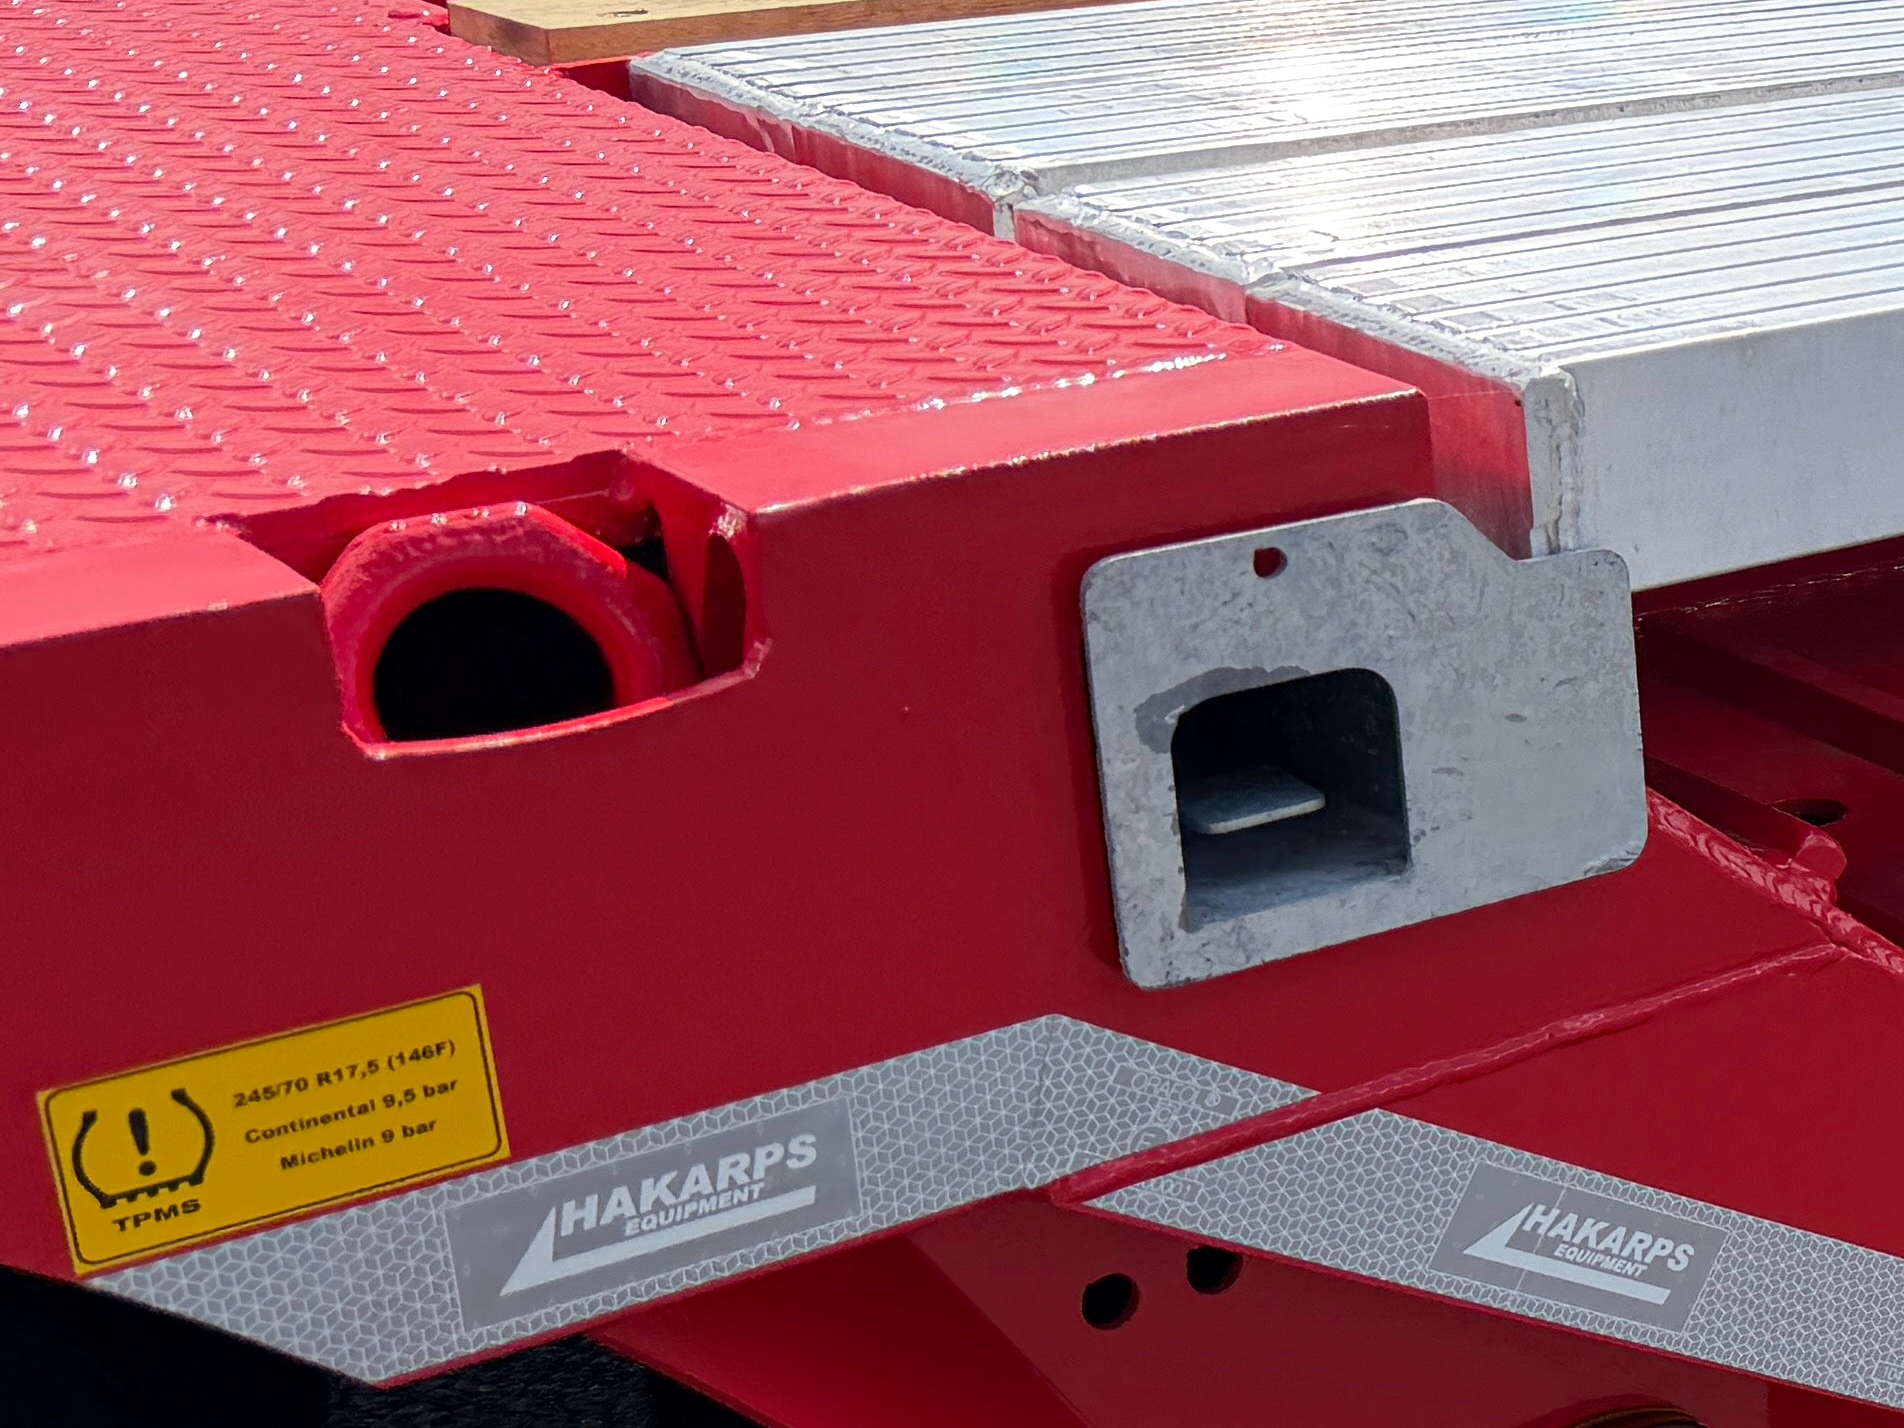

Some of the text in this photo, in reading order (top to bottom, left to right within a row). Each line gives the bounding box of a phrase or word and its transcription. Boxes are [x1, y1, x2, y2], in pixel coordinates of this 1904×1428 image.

[233, 1039, 456, 1109] 245/70 R17,5 (146F)
[245, 1077, 458, 1145] Continental 9,5 bar
[280, 1118, 437, 1170] Michelin 9 bar
[112, 1198, 201, 1233] TPMS
[561, 1134, 817, 1236] HAKARPS
[624, 1181, 765, 1236] EQUIPMENT
[1522, 1204, 1695, 1272] HAKARPS
[1554, 1244, 1648, 1277] EQUIPMENT
